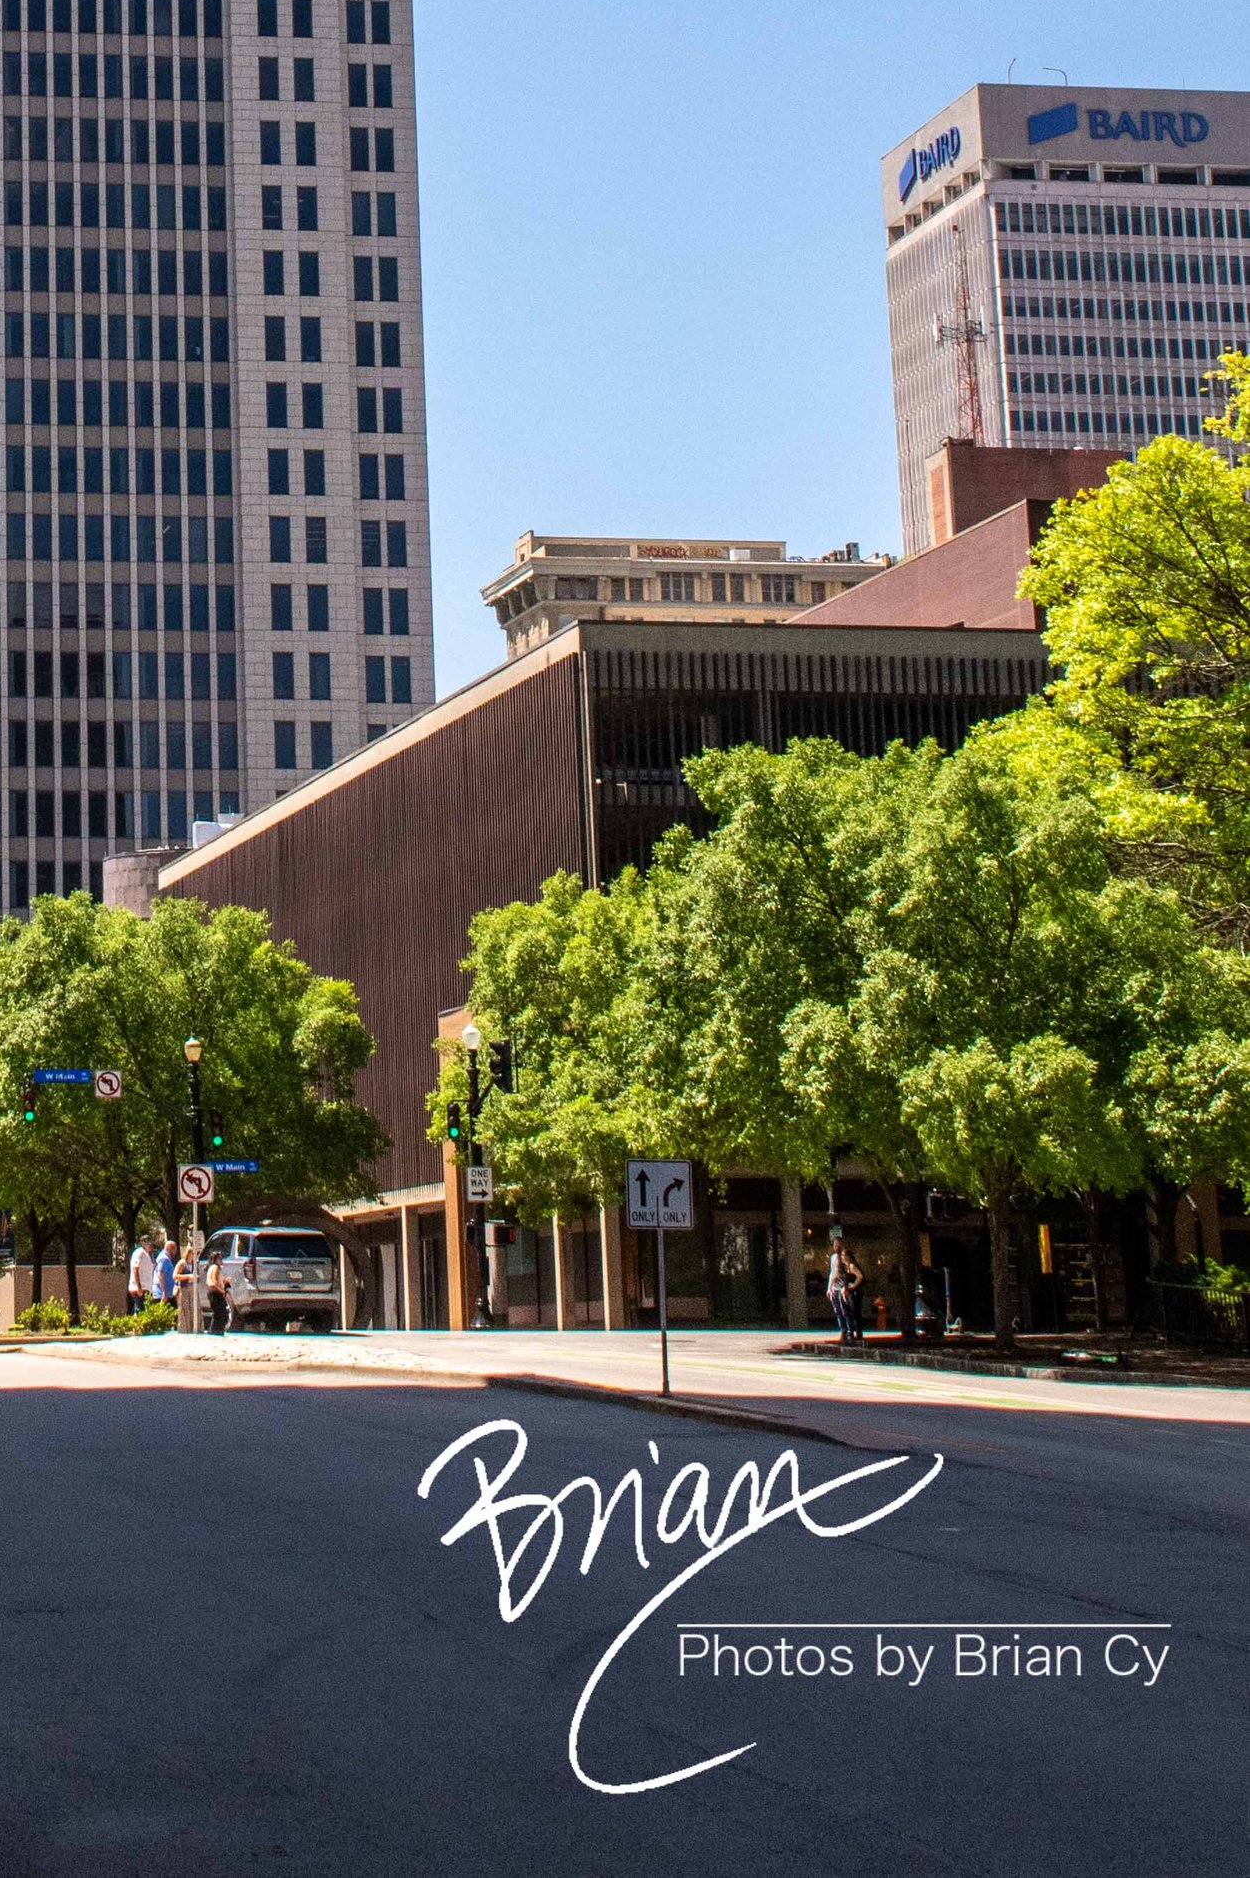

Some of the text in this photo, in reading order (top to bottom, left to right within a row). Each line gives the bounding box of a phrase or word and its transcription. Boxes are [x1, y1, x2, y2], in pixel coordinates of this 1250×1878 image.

[1086, 109, 1210, 149] BAIRD
[916, 126, 961, 182] BAIRD
[471, 1169, 489, 1178] ONE
[471, 1178, 490, 1187] WAY
[631, 1211, 656, 1222] ONLY
[662, 1212, 687, 1223] ONLY
